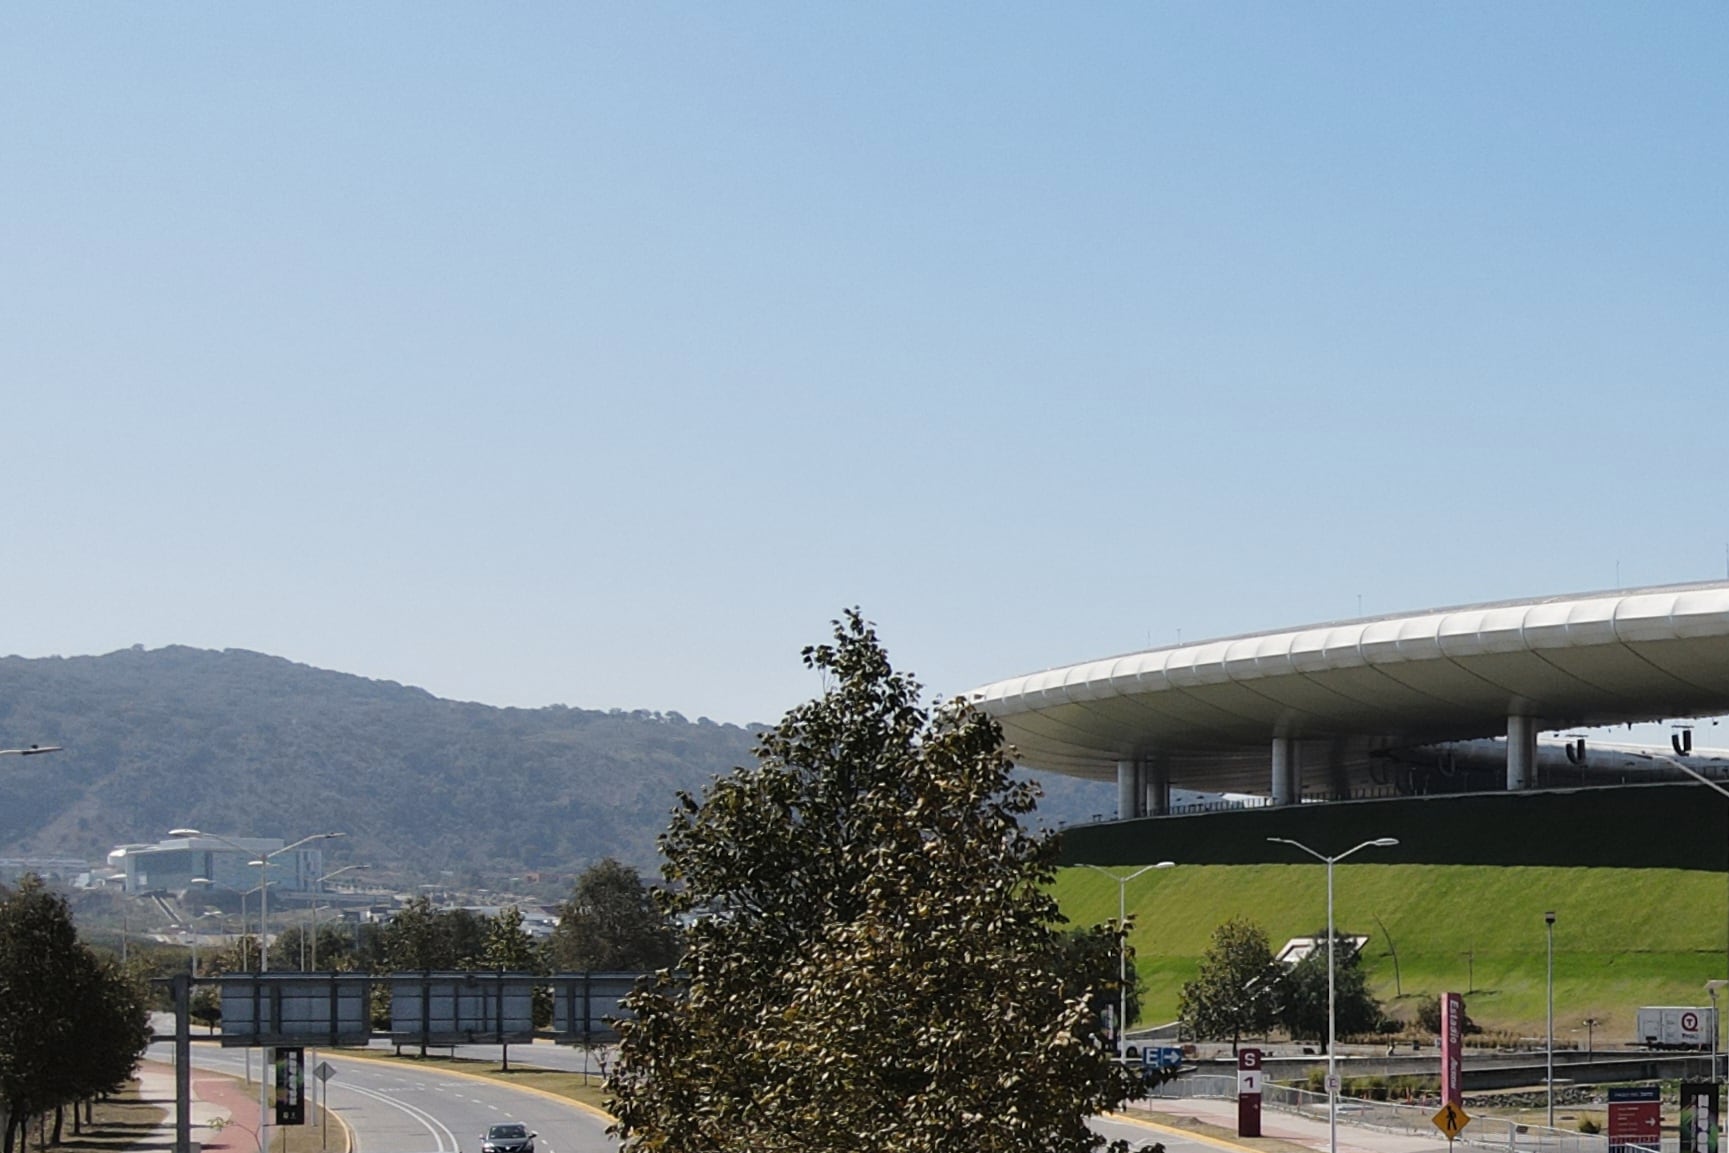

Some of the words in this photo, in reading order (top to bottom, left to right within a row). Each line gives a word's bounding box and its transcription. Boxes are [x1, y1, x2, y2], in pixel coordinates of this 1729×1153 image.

[1450, 1000, 1459, 1044] Estadio
[1146, 1048, 1159, 1066] E
[1244, 1053, 1255, 1067] S
[1244, 1076, 1254, 1089] 1
